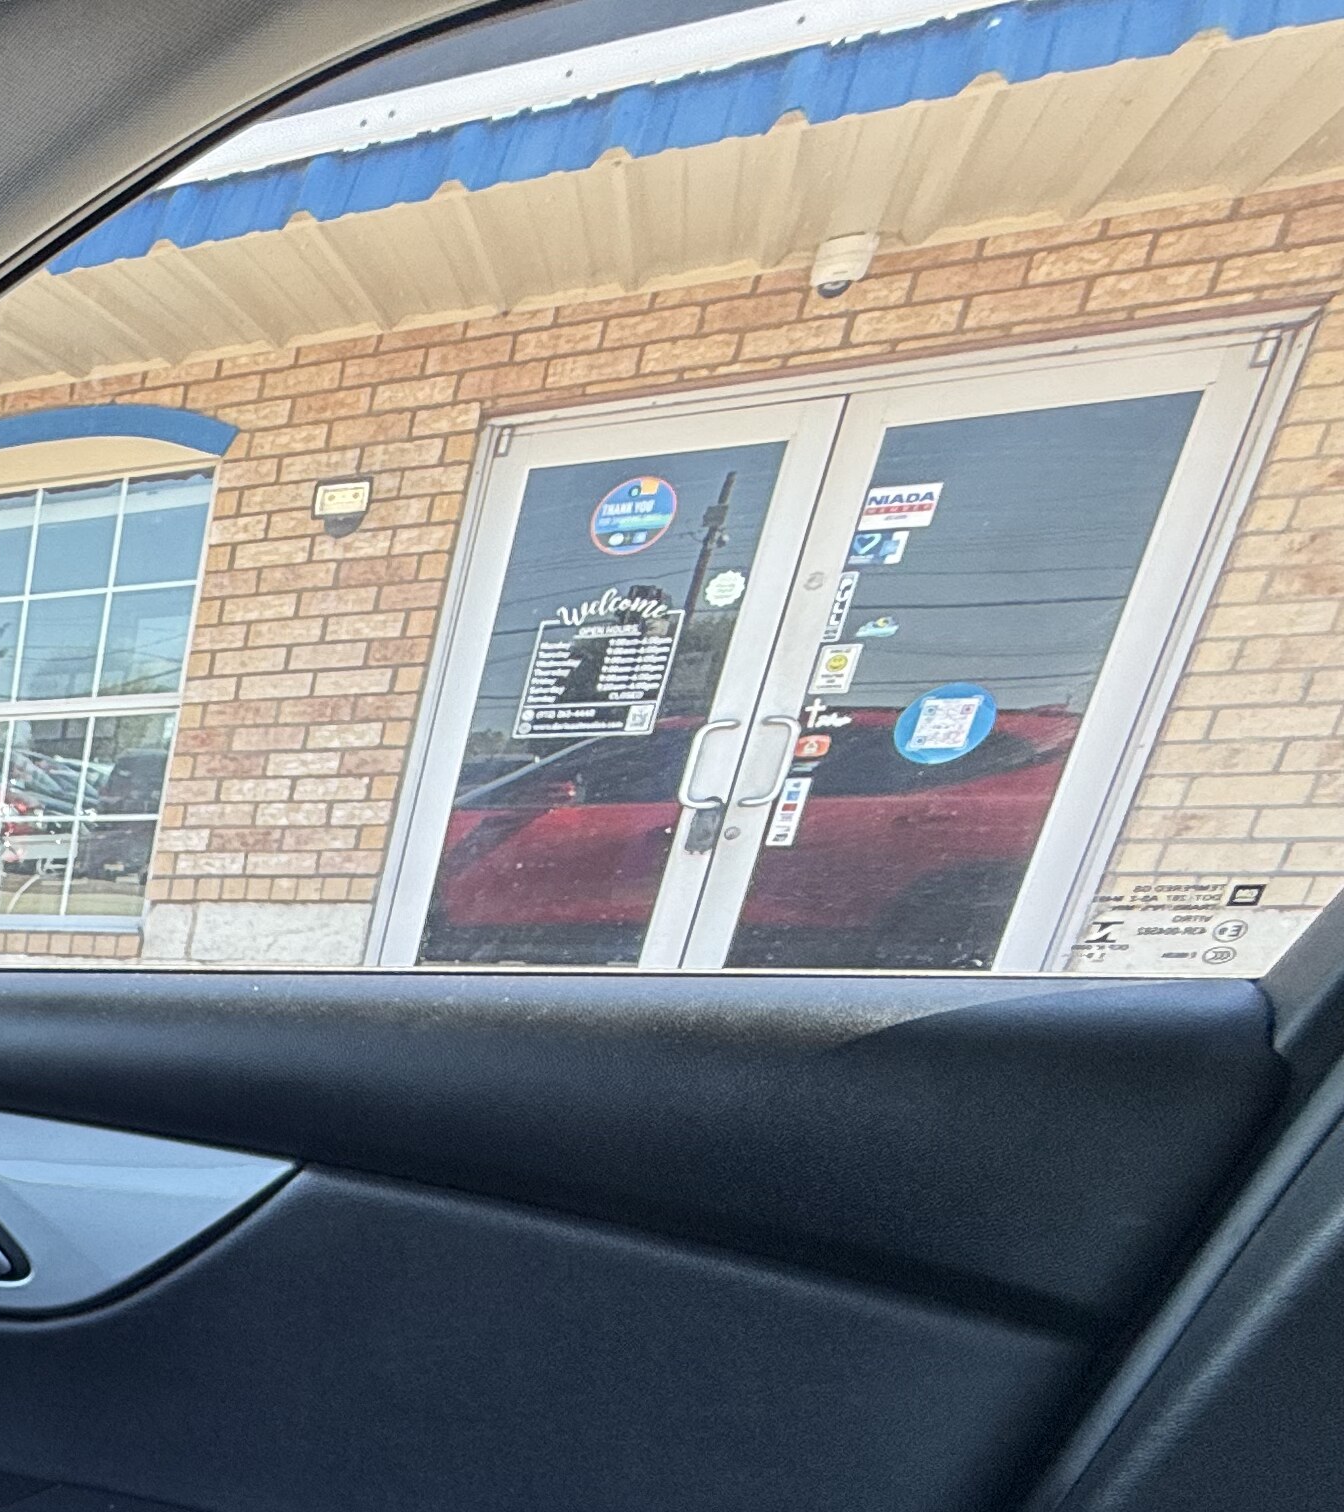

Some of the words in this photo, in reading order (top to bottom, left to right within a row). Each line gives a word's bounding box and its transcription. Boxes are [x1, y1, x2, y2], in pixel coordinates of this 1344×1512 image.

[868, 491, 935, 505] NIADA
[556, 587, 668, 626] Welcome
[579, 626, 605, 636] OPEN
